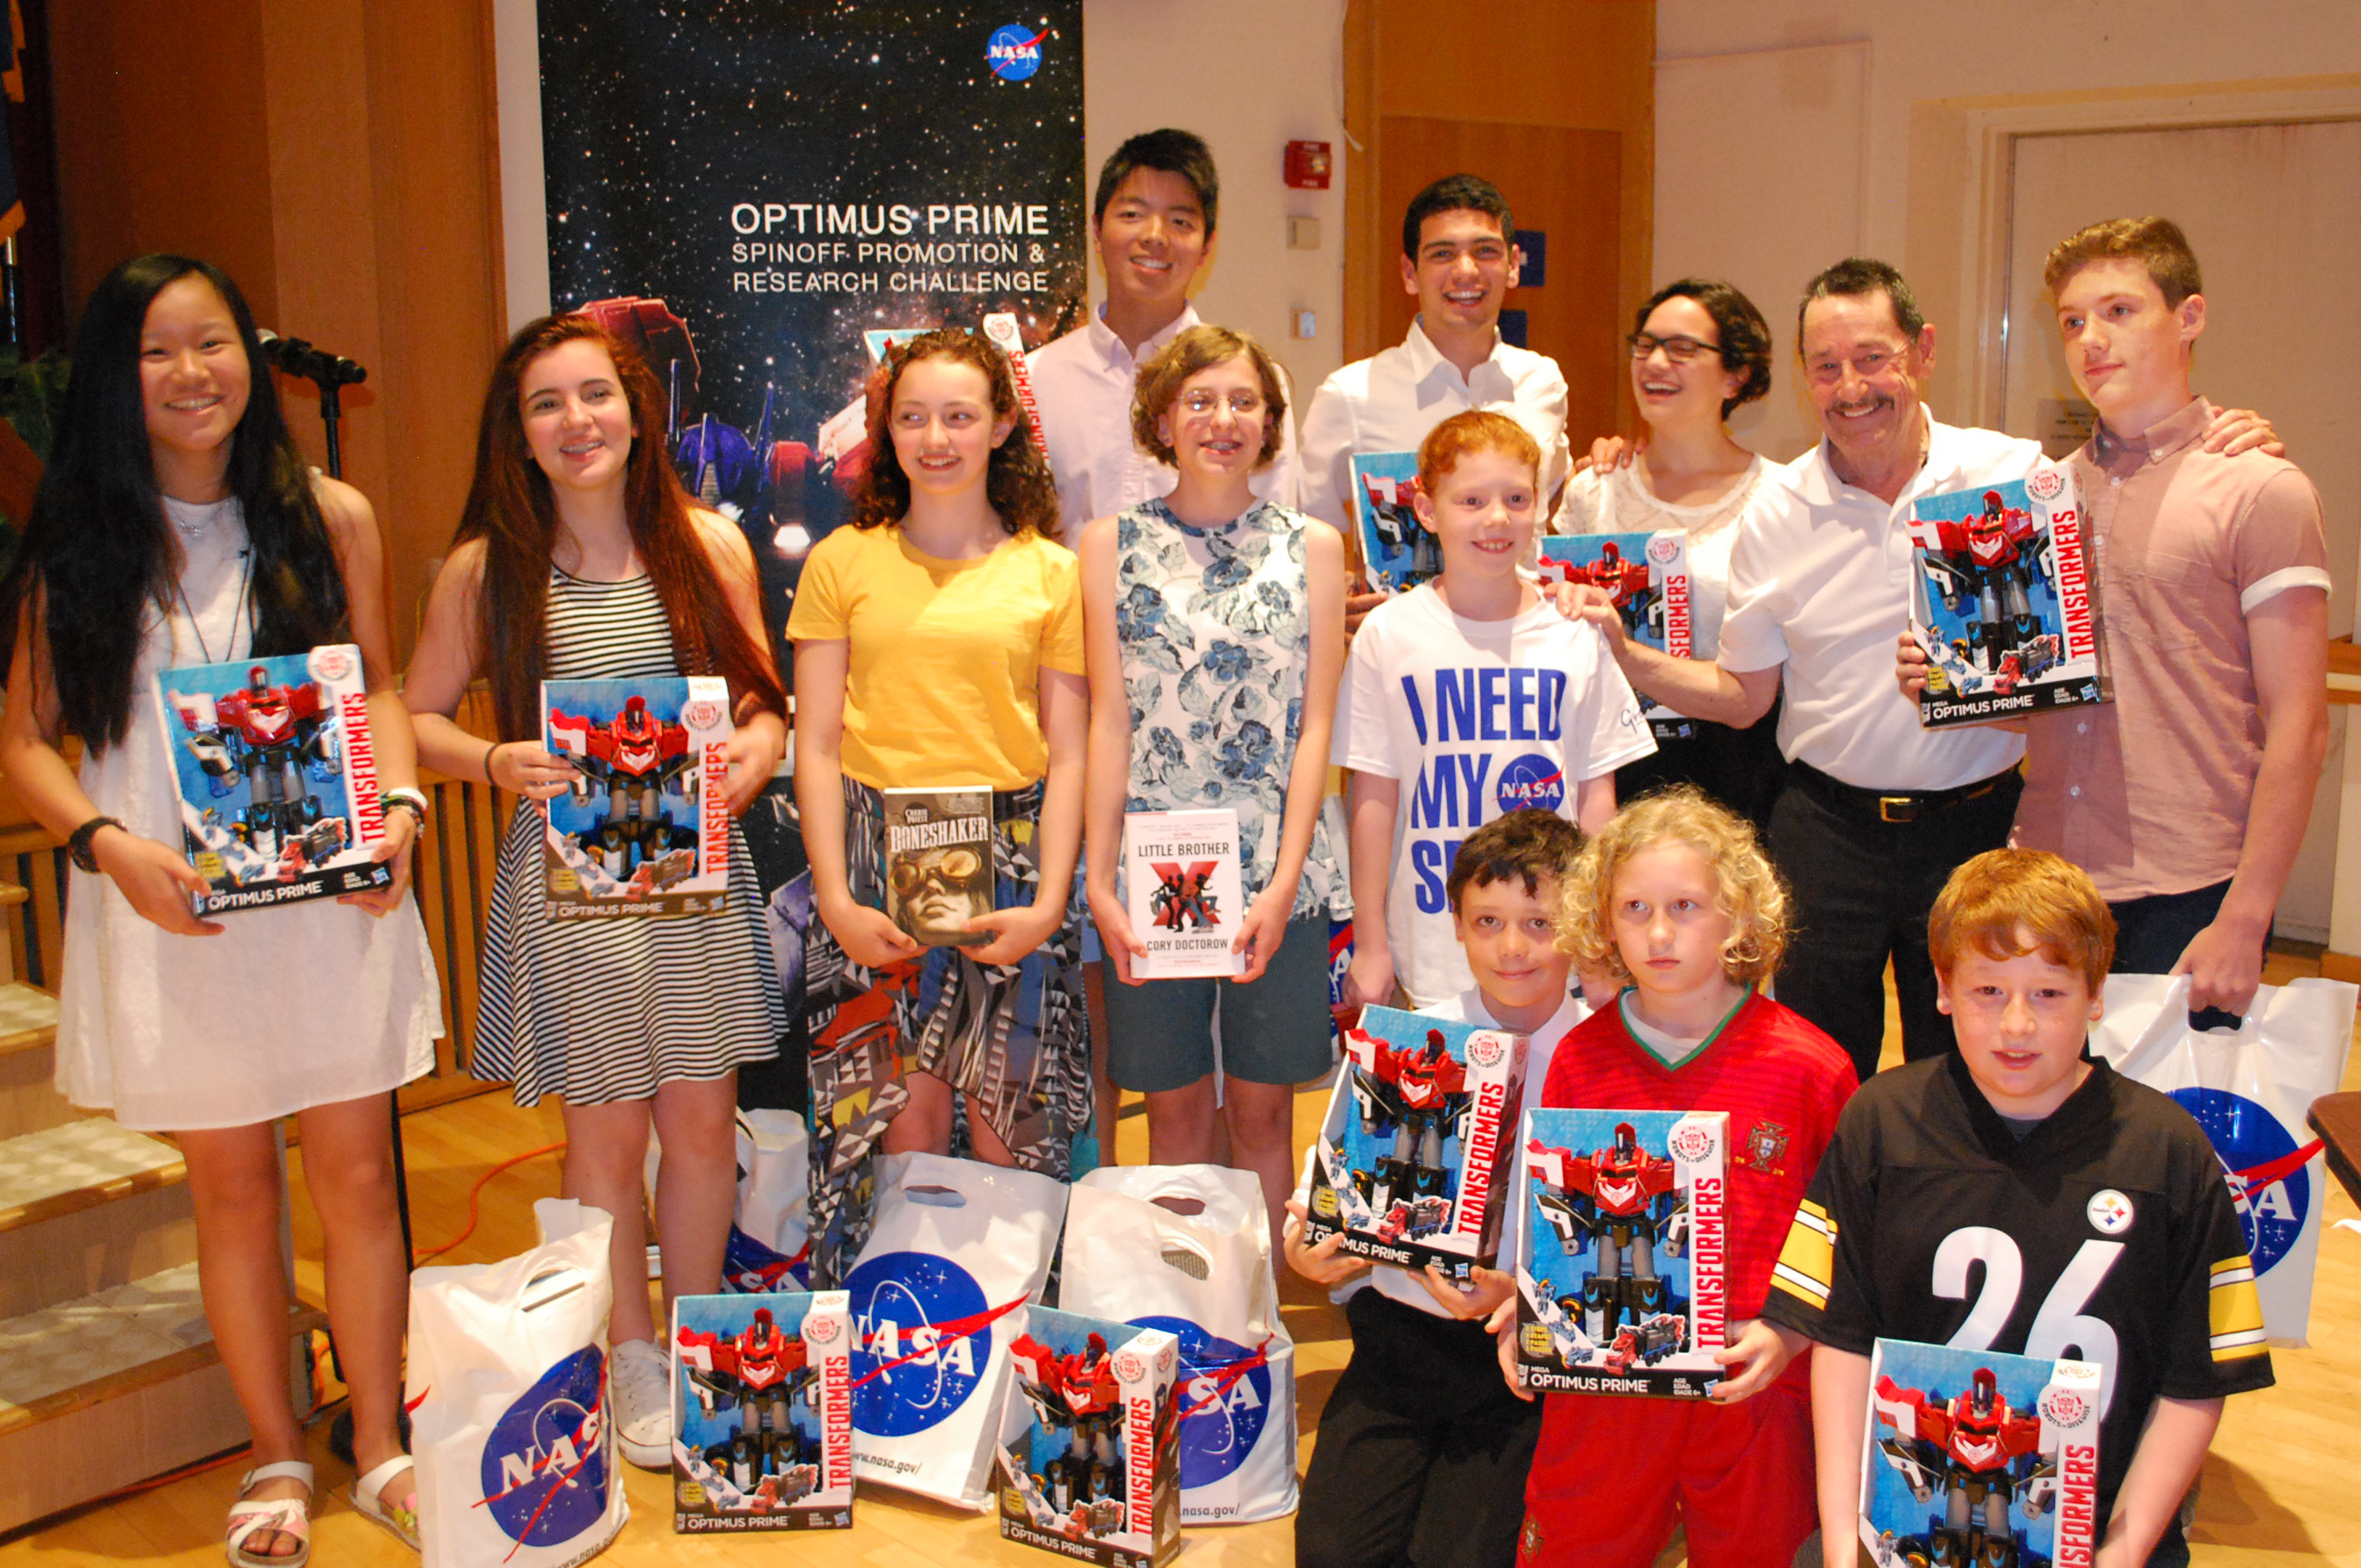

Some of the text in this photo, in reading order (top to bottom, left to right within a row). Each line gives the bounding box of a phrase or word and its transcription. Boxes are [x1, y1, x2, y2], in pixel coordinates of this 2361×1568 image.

[991, 45, 1039, 60] NASA
[730, 203, 1050, 235] OPTIMUS PRIME
[731, 243, 1046, 264] SPINOFF PROMOTION &
[733, 271, 1049, 293] RESEARCH CHALLENGE
[2052, 510, 2096, 659] TRANSFORMERS
[1667, 575, 1691, 659] SFORMERS
[1401, 667, 1567, 746] I NEED
[1934, 694, 2034, 720] OPTIMUS PRIME
[342, 693, 386, 844] TRANSFORMERS
[1411, 753, 1562, 829] MY NASA
[890, 816, 989, 853] BONESHAKER
[1137, 842, 1230, 857] LITTLE BROTHER
[208, 881, 323, 911] OPTIMUS PRIME
[559, 902, 664, 918] OPTIMUS PRIME
[1146, 939, 1229, 951] CORY DOCTOROW
[1457, 1081, 1504, 1235] TRANSFORMERS
[2224, 1173, 2298, 1221] SA
[1370, 1245, 1410, 1264] PRIME
[1695, 1178, 1725, 1348] TRANSFORMERS
[848, 1313, 977, 1376] NASA
[1932, 1226, 2125, 1422] 26
[1188, 1373, 1263, 1416] SA
[1530, 1374, 1649, 1393] OPTIMUS PRIME
[826, 1355, 852, 1489] TRANSFORMERS
[499, 1412, 602, 1495] NAS
[1130, 1397, 1153, 1535] TRANSFORMERS
[688, 1515, 788, 1530] OPTIMUS PRIME
[2059, 1444, 2096, 1568] SFORMERS
[1010, 1526, 1097, 1559] OPTIMUS PRIME
